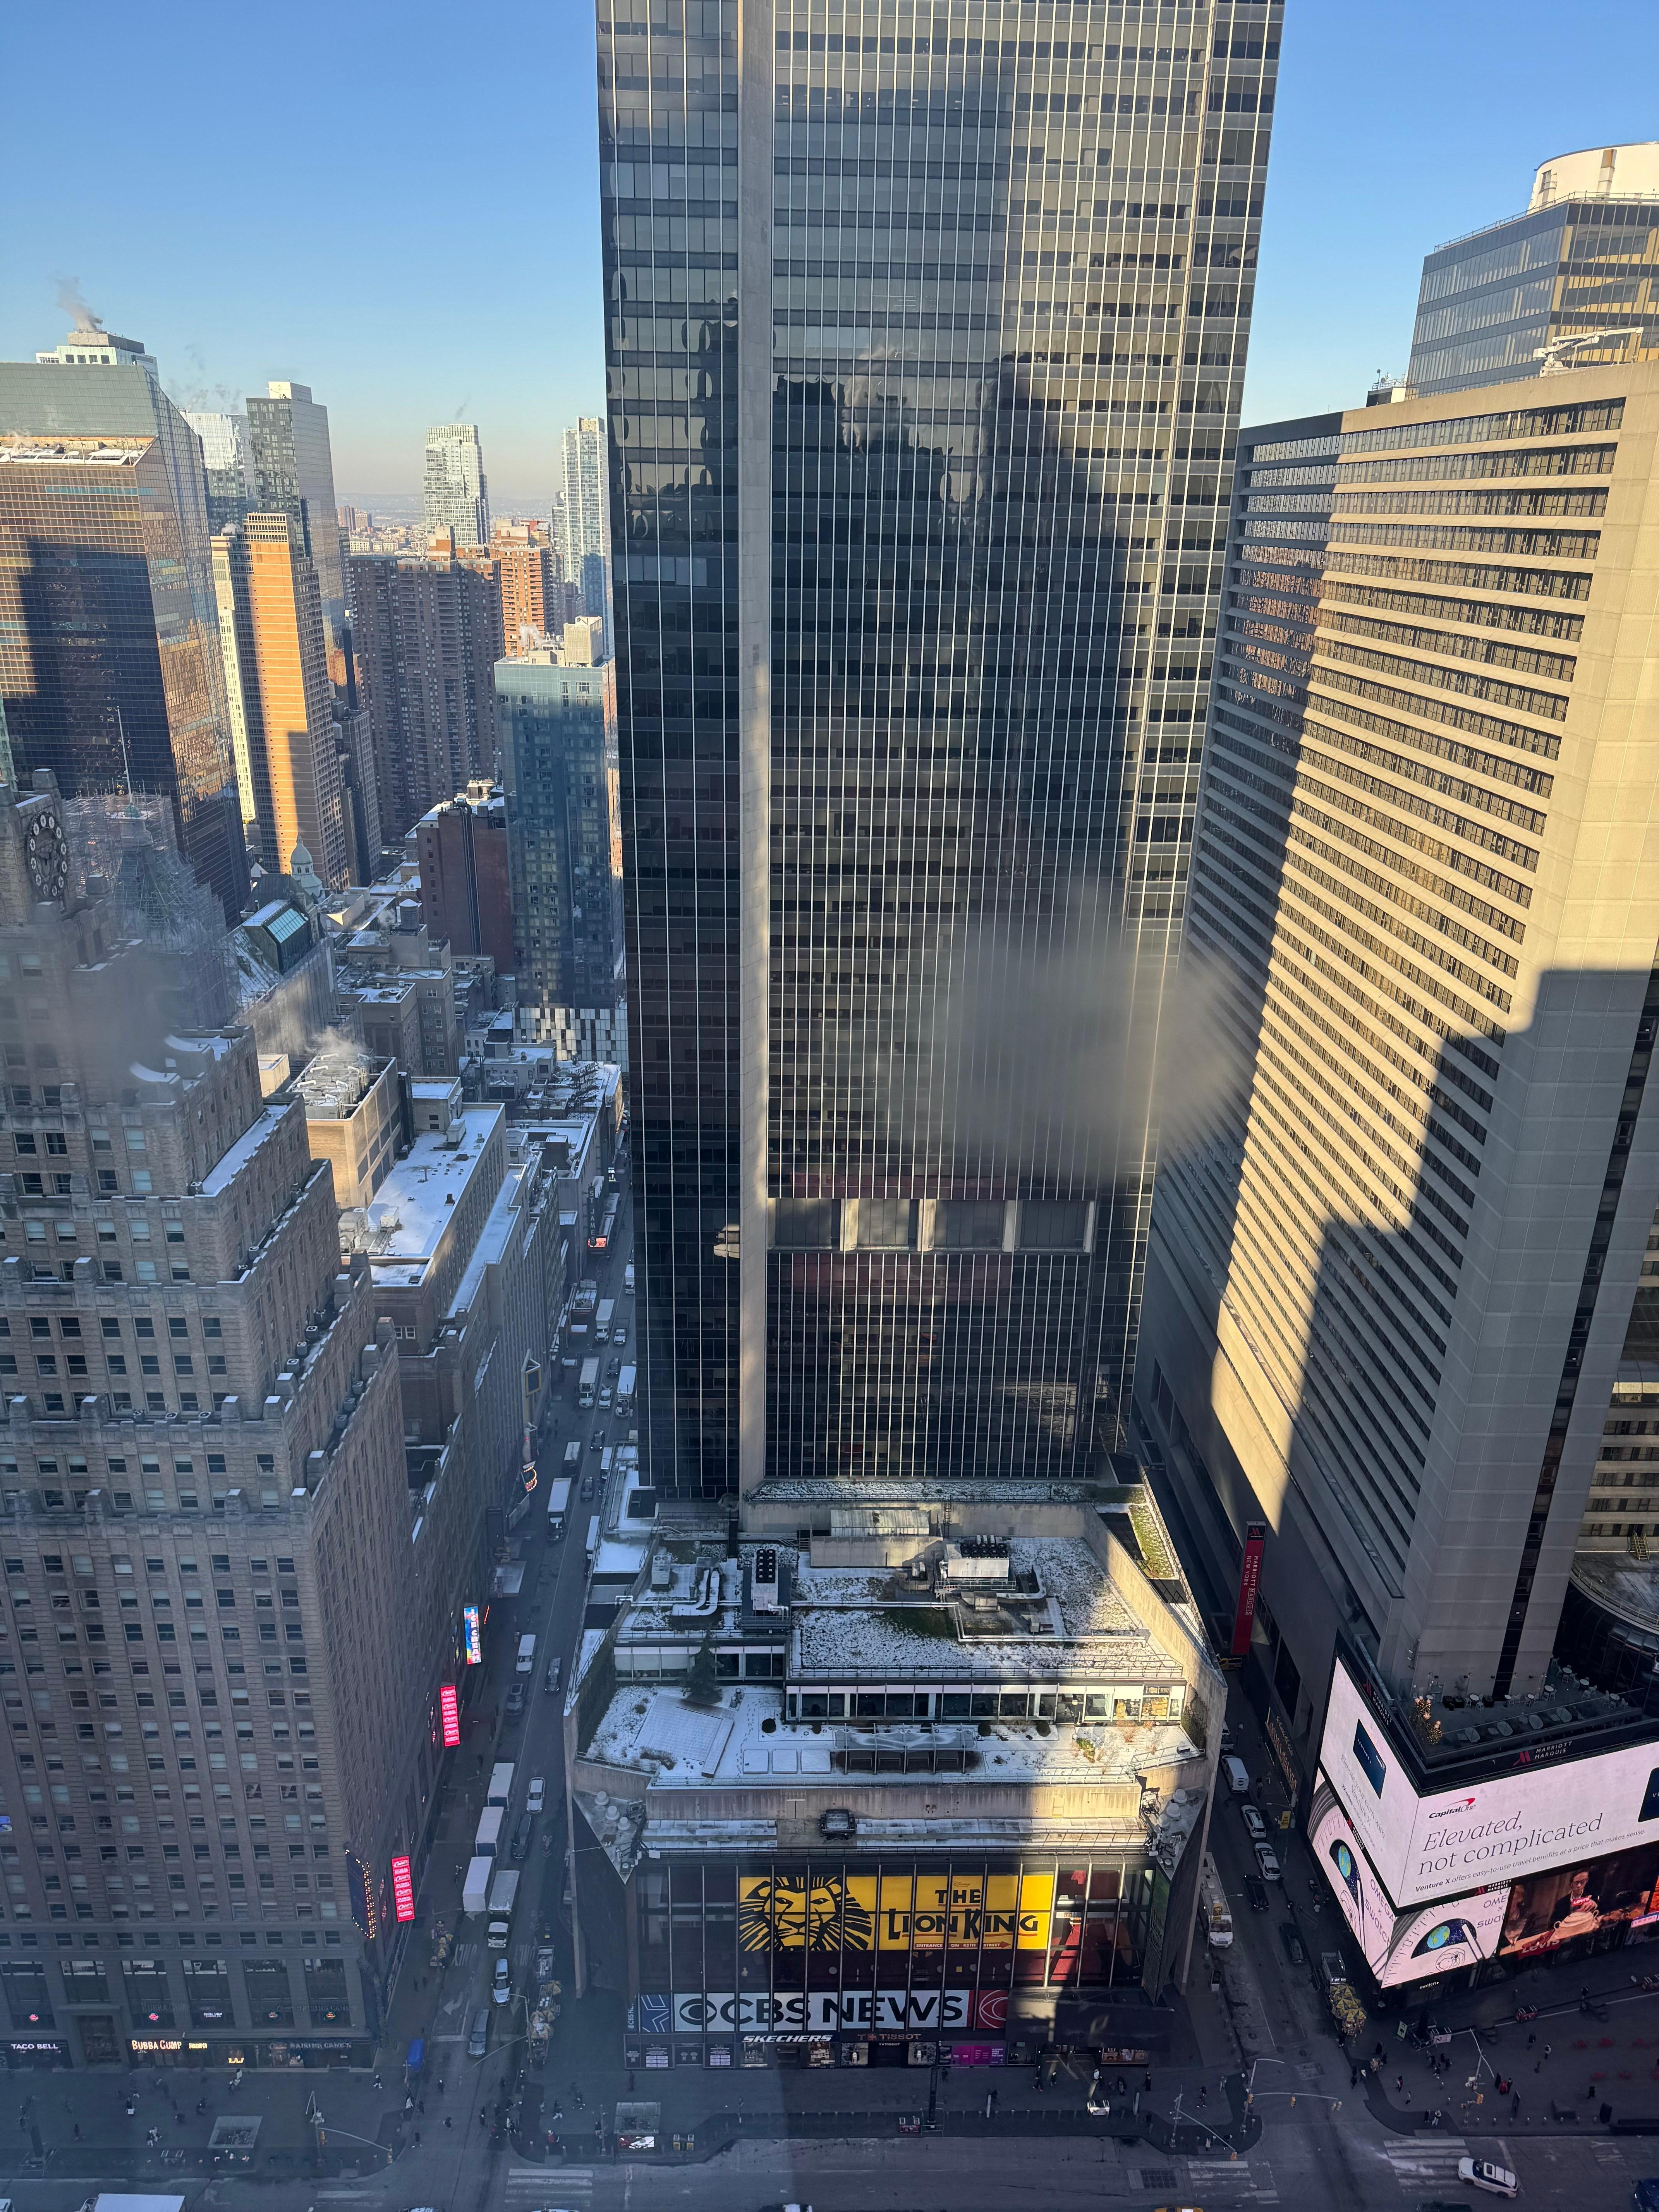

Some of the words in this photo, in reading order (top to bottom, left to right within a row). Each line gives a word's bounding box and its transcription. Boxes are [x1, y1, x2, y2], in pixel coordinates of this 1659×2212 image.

[589, 1190, 594, 1203] ST
[1250, 1556, 1259, 1587] MARRIOTT
[1246, 1588, 1255, 1615] MARQUIS
[1373, 1697, 1389, 1726] MARQUIS
[1374, 1691, 1392, 1723] MARRIOTT
[1535, 1748, 1566, 1759] MARQUIS
[1536, 1741, 1572, 1753] MARRIOTT
[1341, 1754, 1355, 1782] Elevate
[1355, 1781, 1365, 1800] your
[1375, 1818, 1385, 1839] with
[1352, 1784, 1367, 1817] Venture
[1419, 1855, 1456, 1875] not
[1463, 1813, 1603, 1856] complicated
[1422, 1811, 1523, 1852] Elevated,
[1415, 1882, 1443, 1893] Venture
[1451, 1873, 1471, 1884] offers
[1472, 1863, 1511, 1879] easy-to-use
[1512, 1858, 1532, 1868] travel
[1532, 1851, 1558, 1863] benefits
[1573, 1843, 1589, 1854] price
[1590, 1839, 1603, 1848] that
[1605, 1834, 1625, 1843] makes
[935, 1889, 980, 1904] THE
[1488, 1879, 1512, 1888] MARRIOTT
[1370, 1879, 1395, 1923] OMEGA
[888, 1908, 957, 1940] LION
[964, 1908, 1038, 1940] KING
[720, 1998, 811, 2025] CBS
[822, 1995, 963, 2023] NEWS
[132, 2040, 159, 2050] BUBBA
[160, 2040, 182, 2050] GUMP
[742, 2034, 833, 2043] SKECHERS
